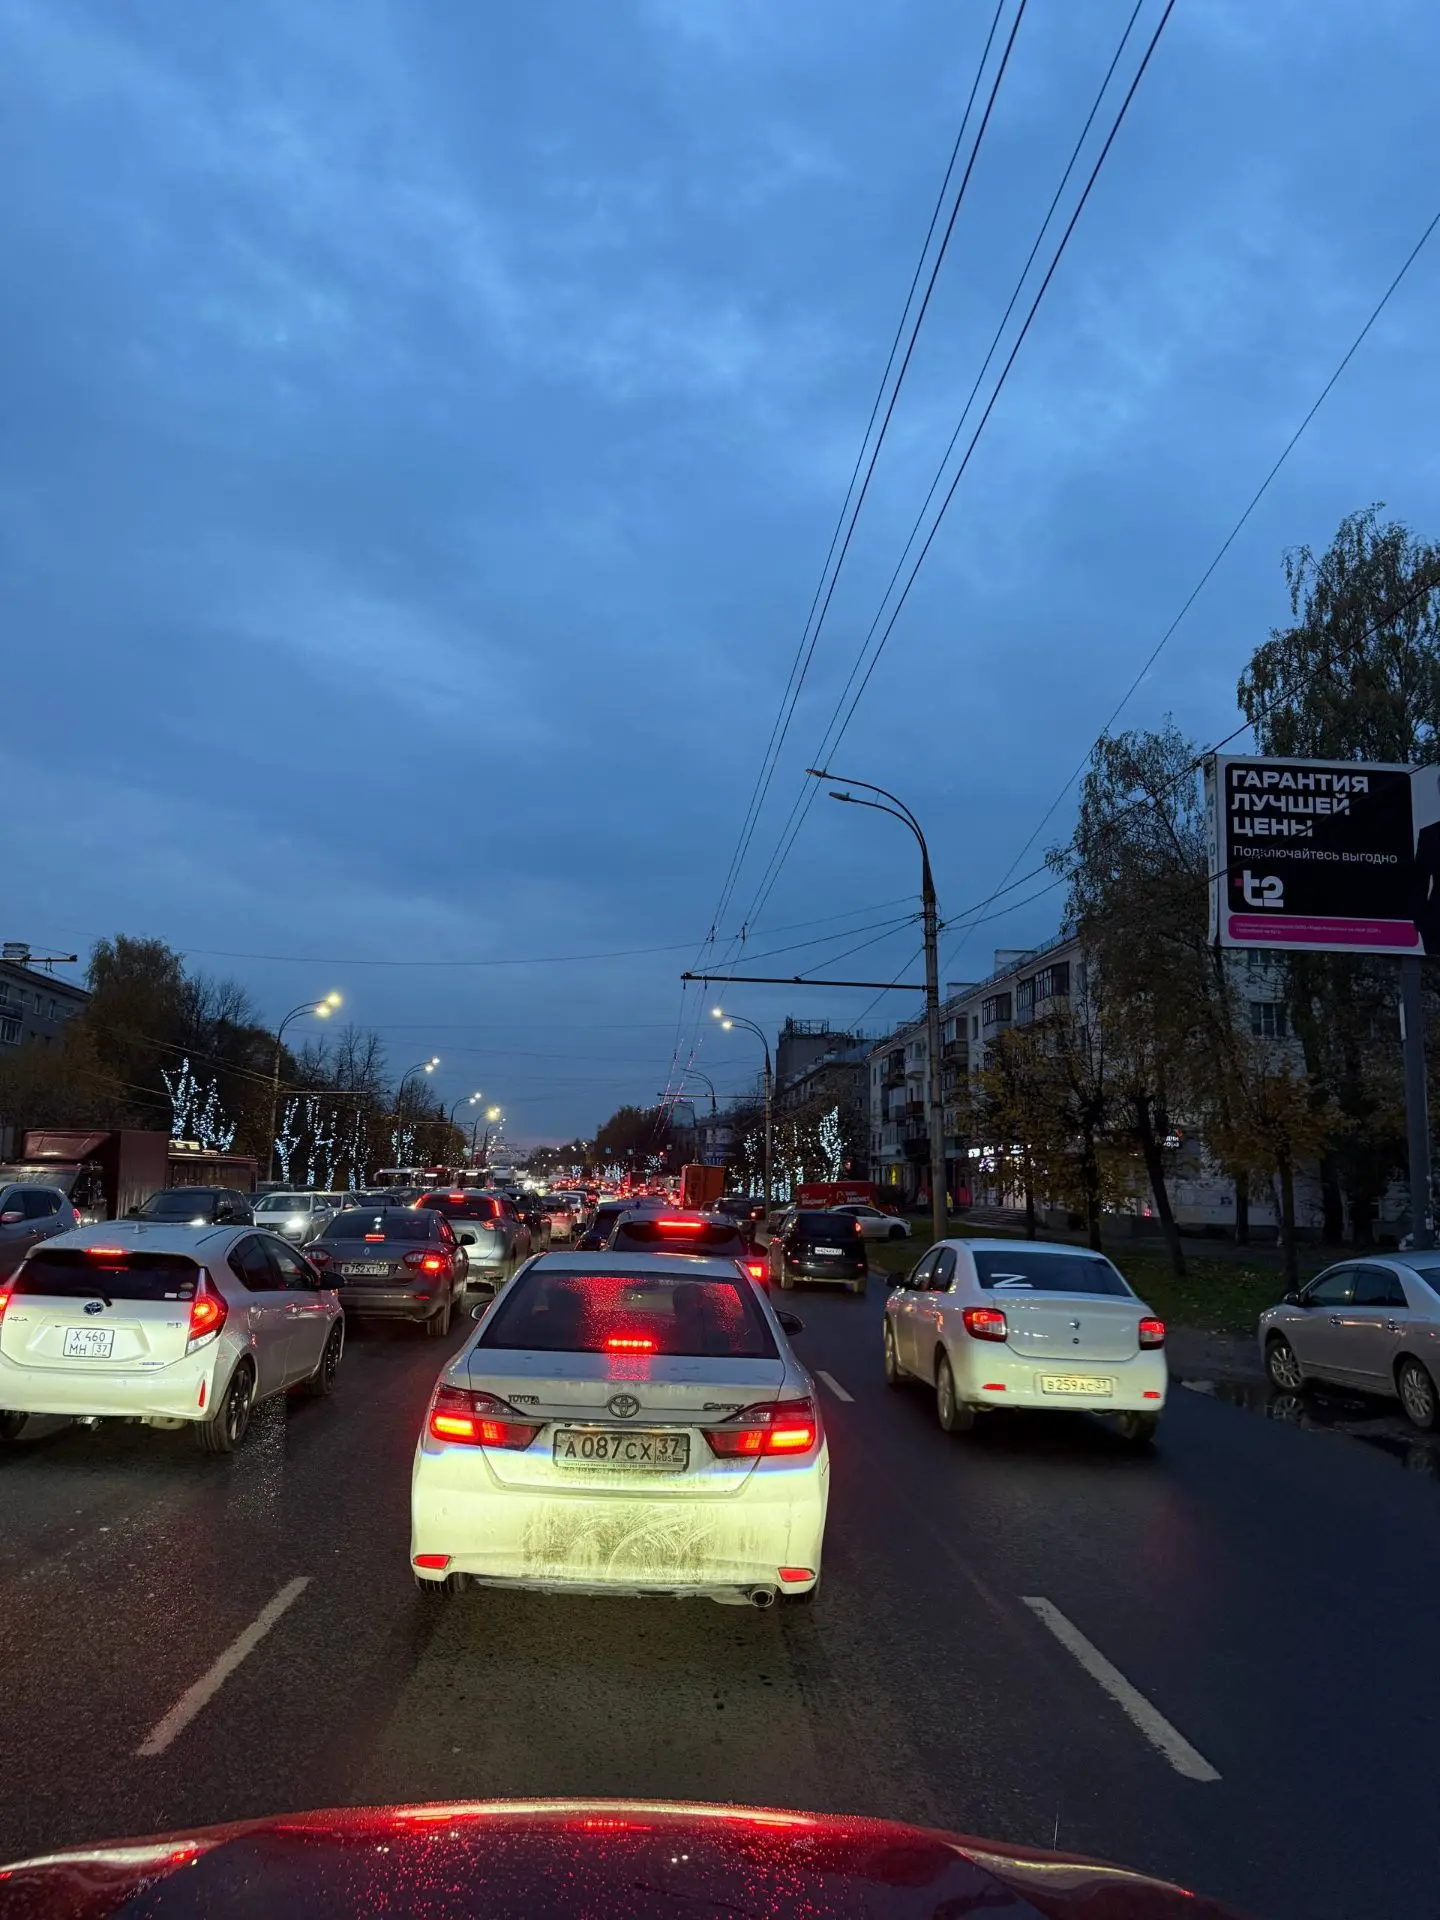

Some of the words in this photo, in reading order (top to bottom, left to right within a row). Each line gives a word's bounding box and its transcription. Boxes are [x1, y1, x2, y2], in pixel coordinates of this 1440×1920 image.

[1231, 769, 1369, 794] ГАРАНТИЯ
[1231, 792, 1351, 816] ЛУЧШЕЙ
[1232, 816, 1313, 837] ЦЕНЫ
[1233, 845, 1340, 862] Подключайтесь
[1342, 851, 1399, 865] выгодно
[1242, 869, 1285, 908] t2
[95, 1344, 108, 1353] 37
[658, 1438, 680, 1455] 37
[657, 1455, 672, 1463] RUS
